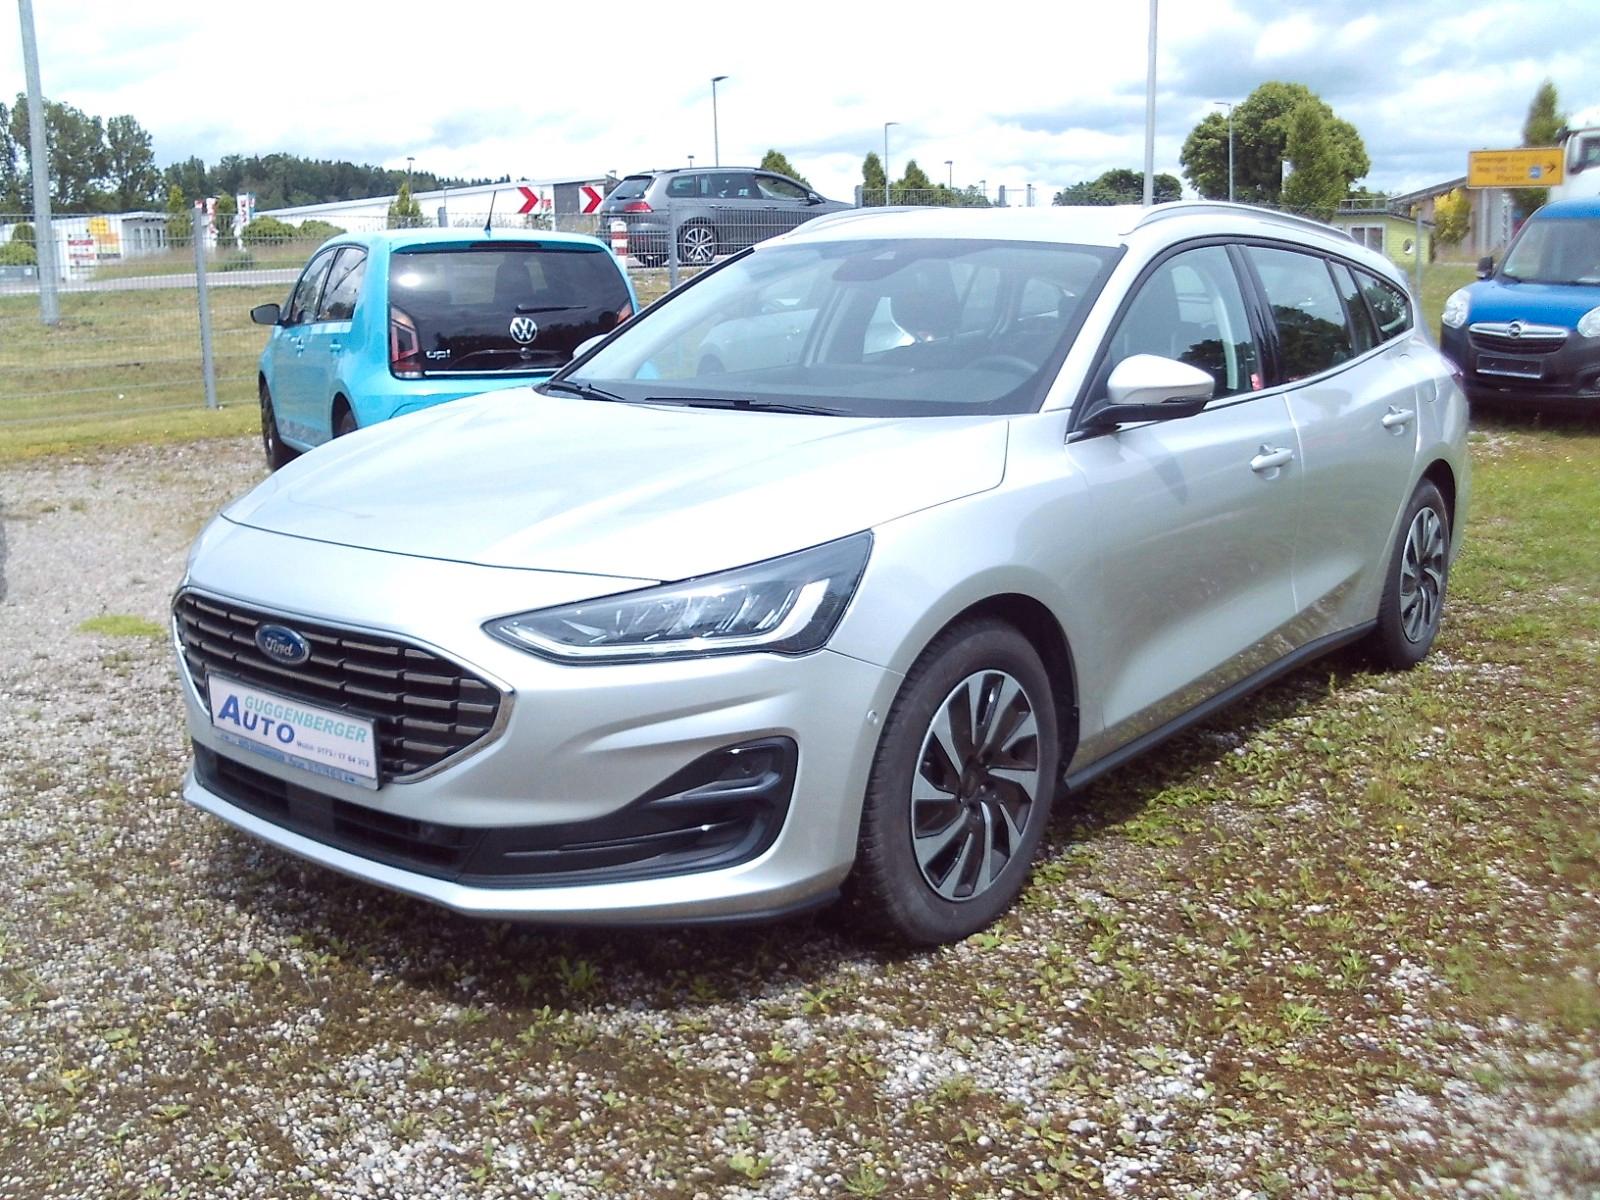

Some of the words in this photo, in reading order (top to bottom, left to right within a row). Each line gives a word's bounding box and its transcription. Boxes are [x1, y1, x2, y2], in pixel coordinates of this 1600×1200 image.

[425, 349, 451, 360] up!
[264, 637, 294, 657] Ford
[218, 694, 295, 743] AUTO
[244, 695, 368, 743] GUGGENBERGER
